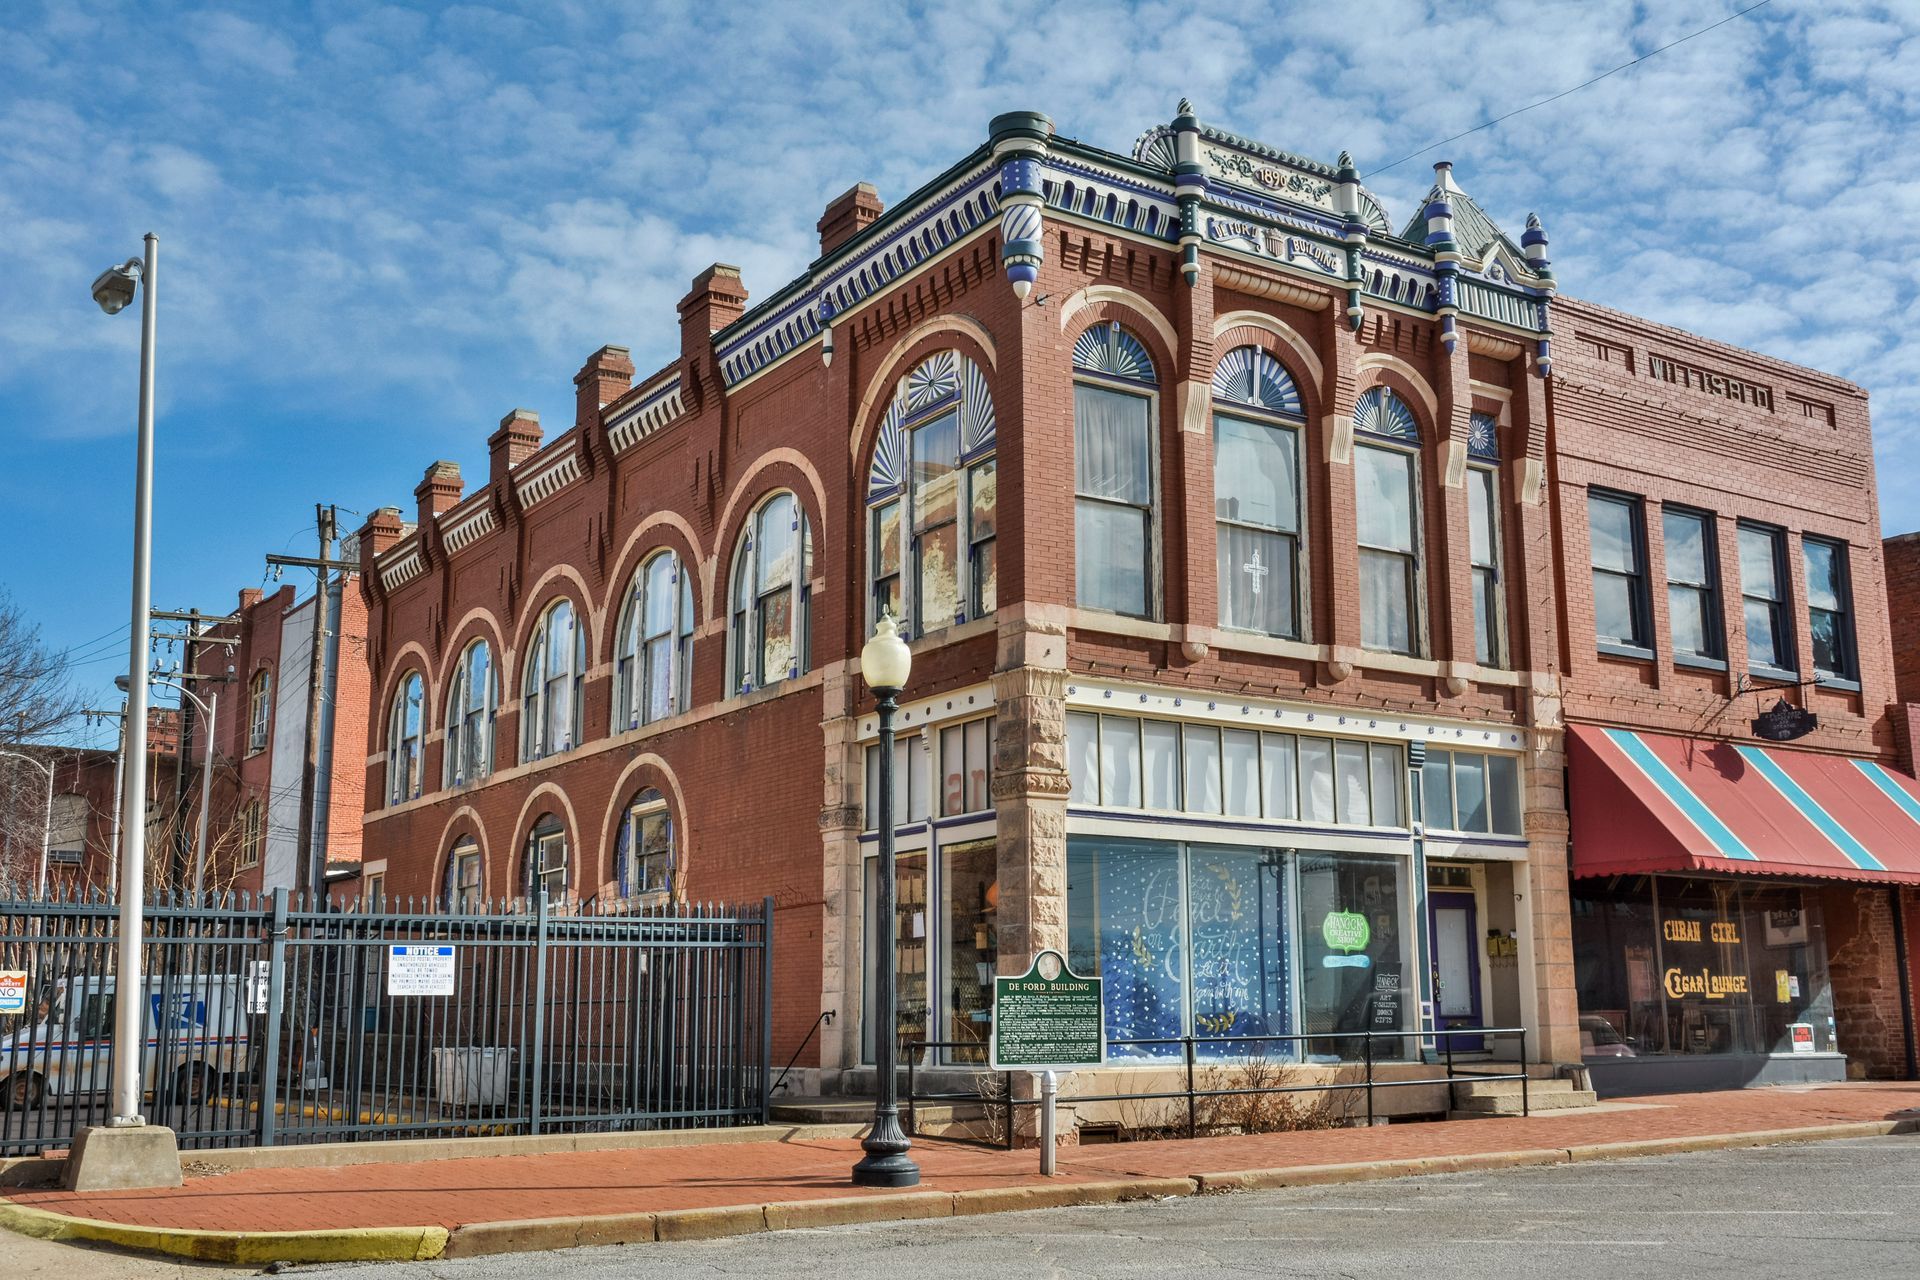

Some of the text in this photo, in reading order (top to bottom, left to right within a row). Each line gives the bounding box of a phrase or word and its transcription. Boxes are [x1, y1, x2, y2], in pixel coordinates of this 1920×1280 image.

[1259, 169, 1287, 187] 1890
[1230, 222, 1259, 237] FORD
[1293, 240, 1338, 269] BUILDING
[1330, 930, 1363, 938] CREATIVE
[1664, 920, 1740, 943] CUBAN GIRL
[407, 947, 439, 956] NOTICE
[1008, 983, 1090, 991] DE FORD BUILDING
[1376, 1008, 1393, 1016] BOOKS
[1374, 1016, 1393, 1024] GIFTS
[1796, 1027, 1809, 1035] FOR
